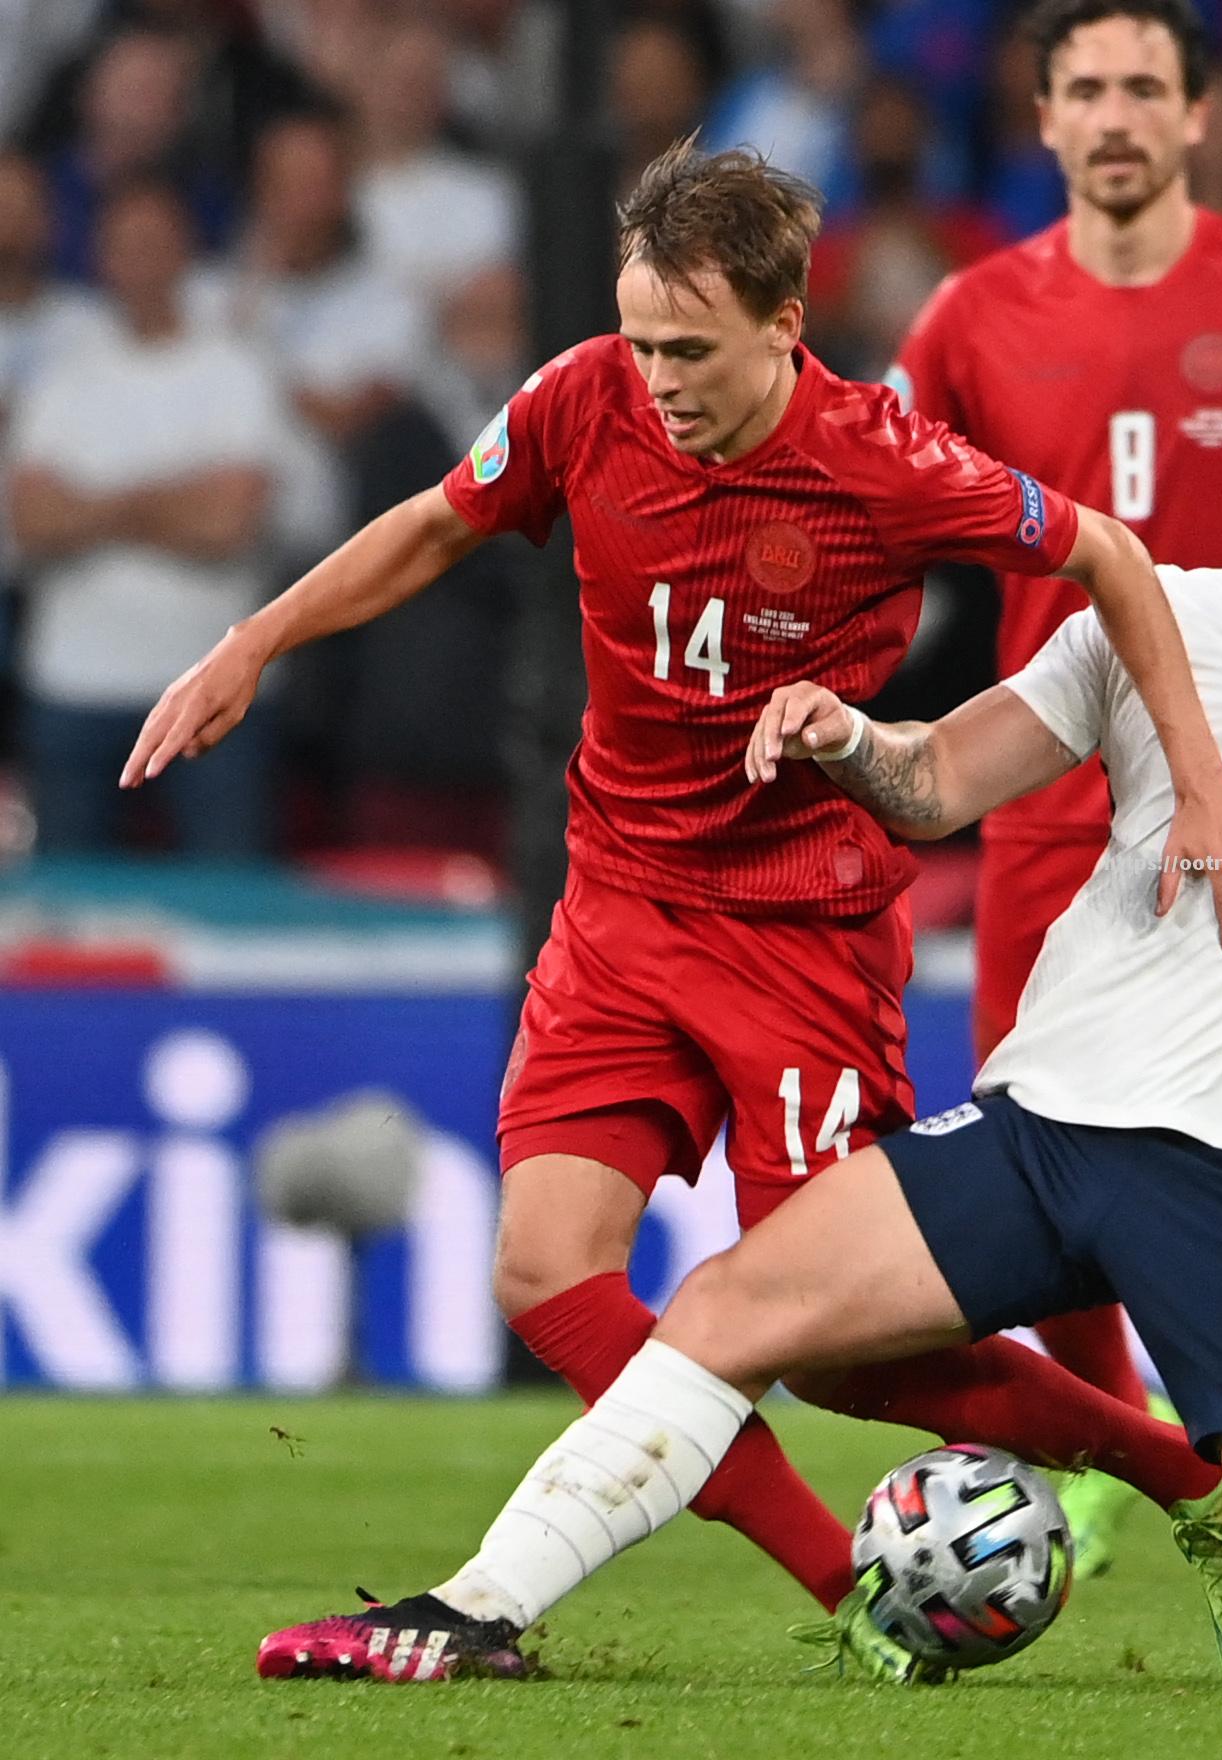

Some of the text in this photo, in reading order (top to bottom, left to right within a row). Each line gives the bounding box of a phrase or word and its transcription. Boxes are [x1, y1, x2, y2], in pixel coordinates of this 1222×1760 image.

[1109, 410, 1156, 521] 8
[648, 581, 730, 697] 14
[779, 1067, 860, 1175] 14
